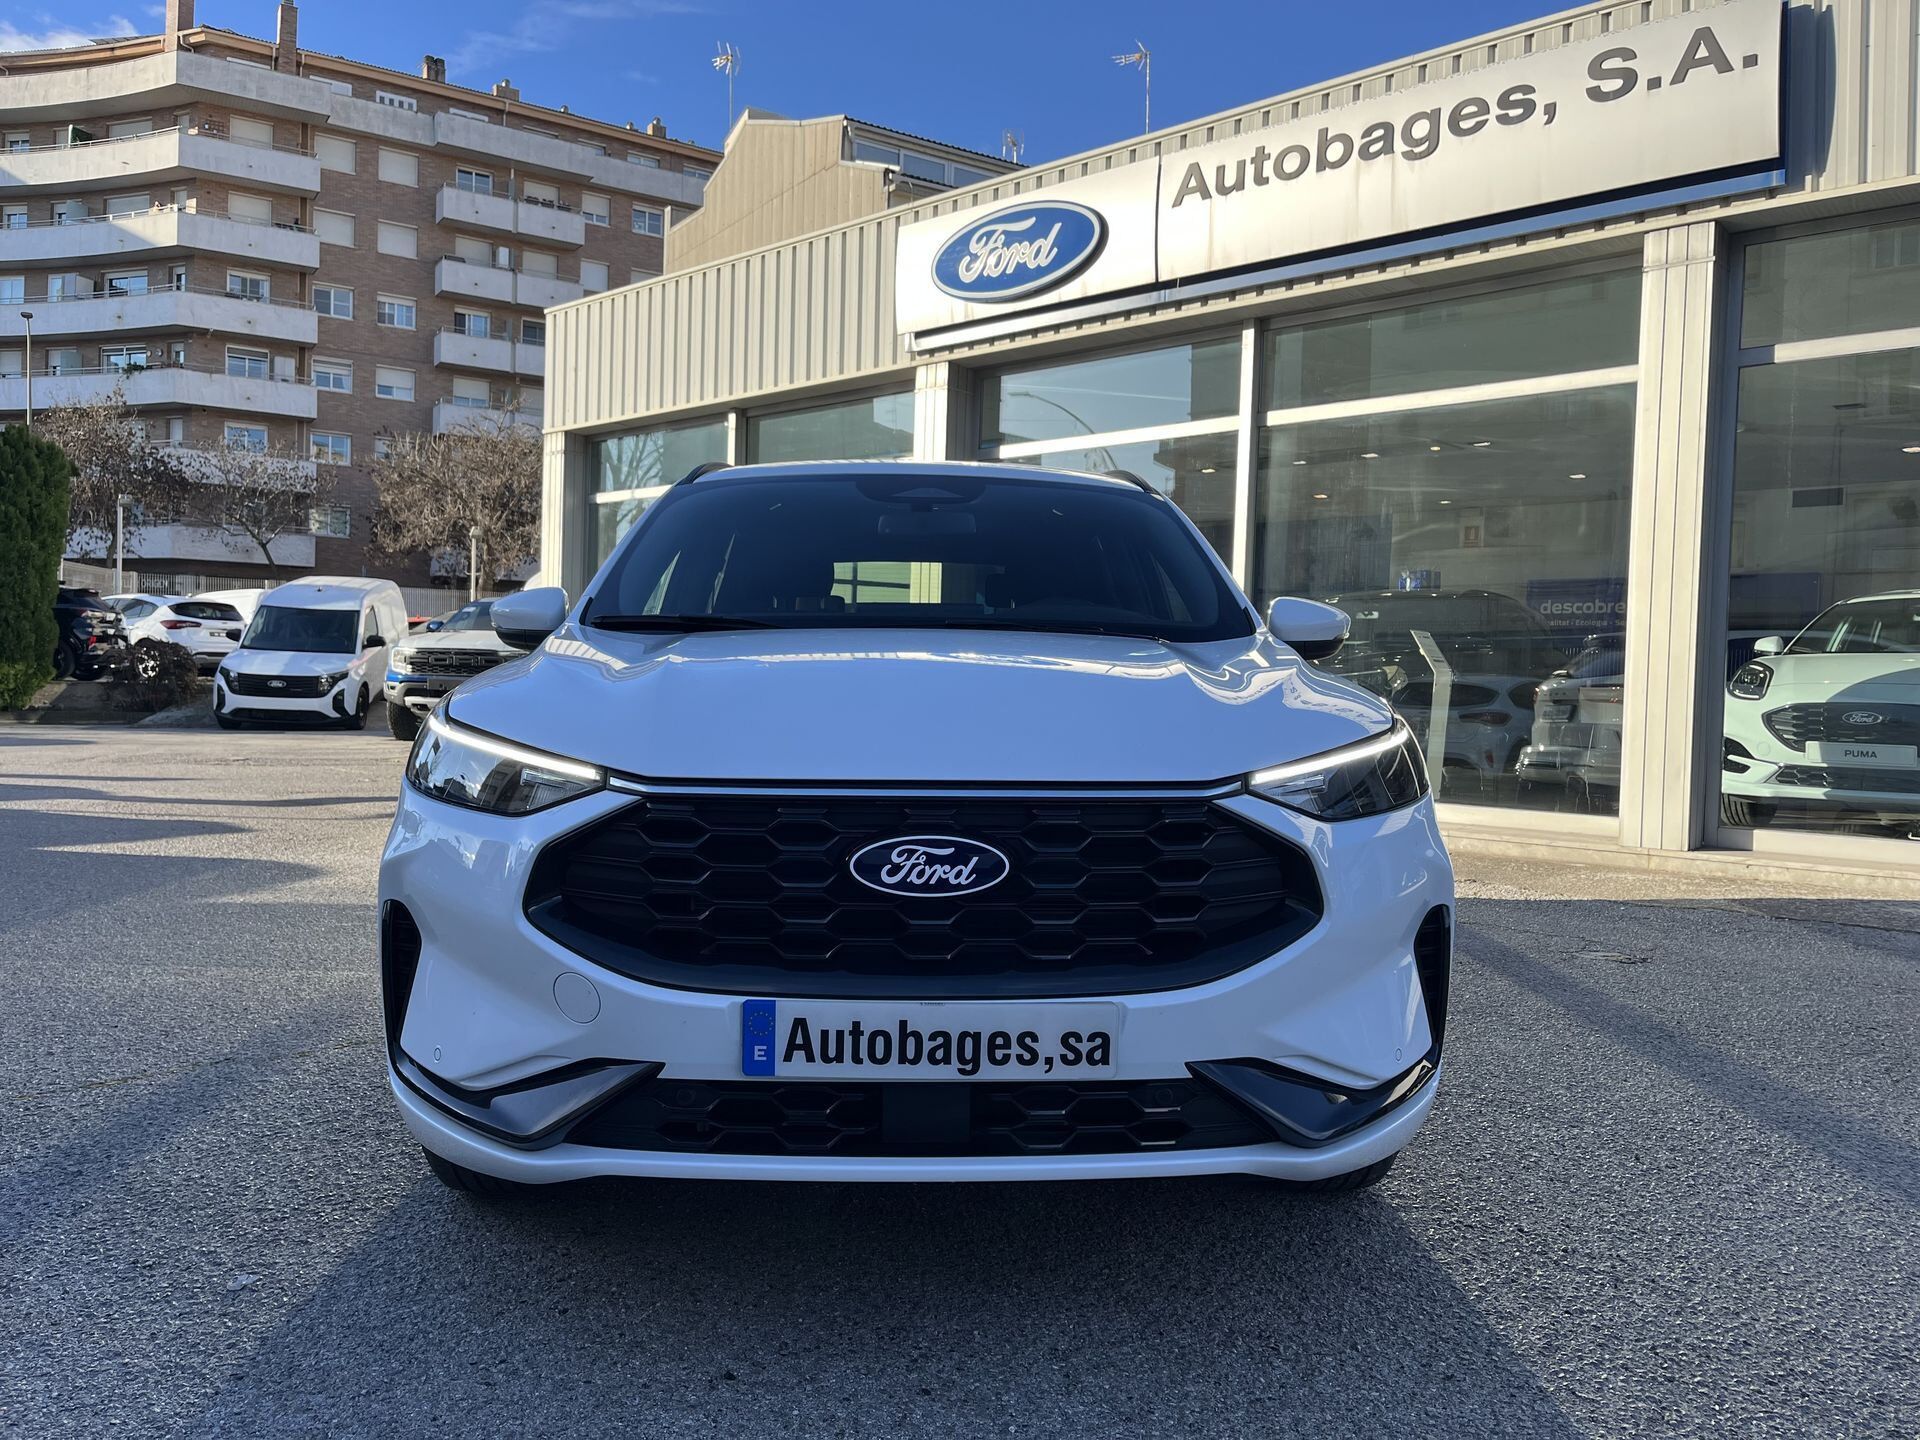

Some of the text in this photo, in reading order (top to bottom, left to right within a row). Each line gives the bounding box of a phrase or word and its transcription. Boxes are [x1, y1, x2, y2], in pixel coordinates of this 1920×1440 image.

[1172, 25, 1759, 208] Autobages, S.A.
[958, 216, 1063, 284] Ford
[1540, 598, 1626, 615] descobre
[1849, 712, 1874, 723] Ford
[1844, 749, 1878, 759] PUMA
[881, 845, 980, 885] Ford
[754, 1045, 767, 1060] E
[783, 1017, 1111, 1076] Autobages,sa
